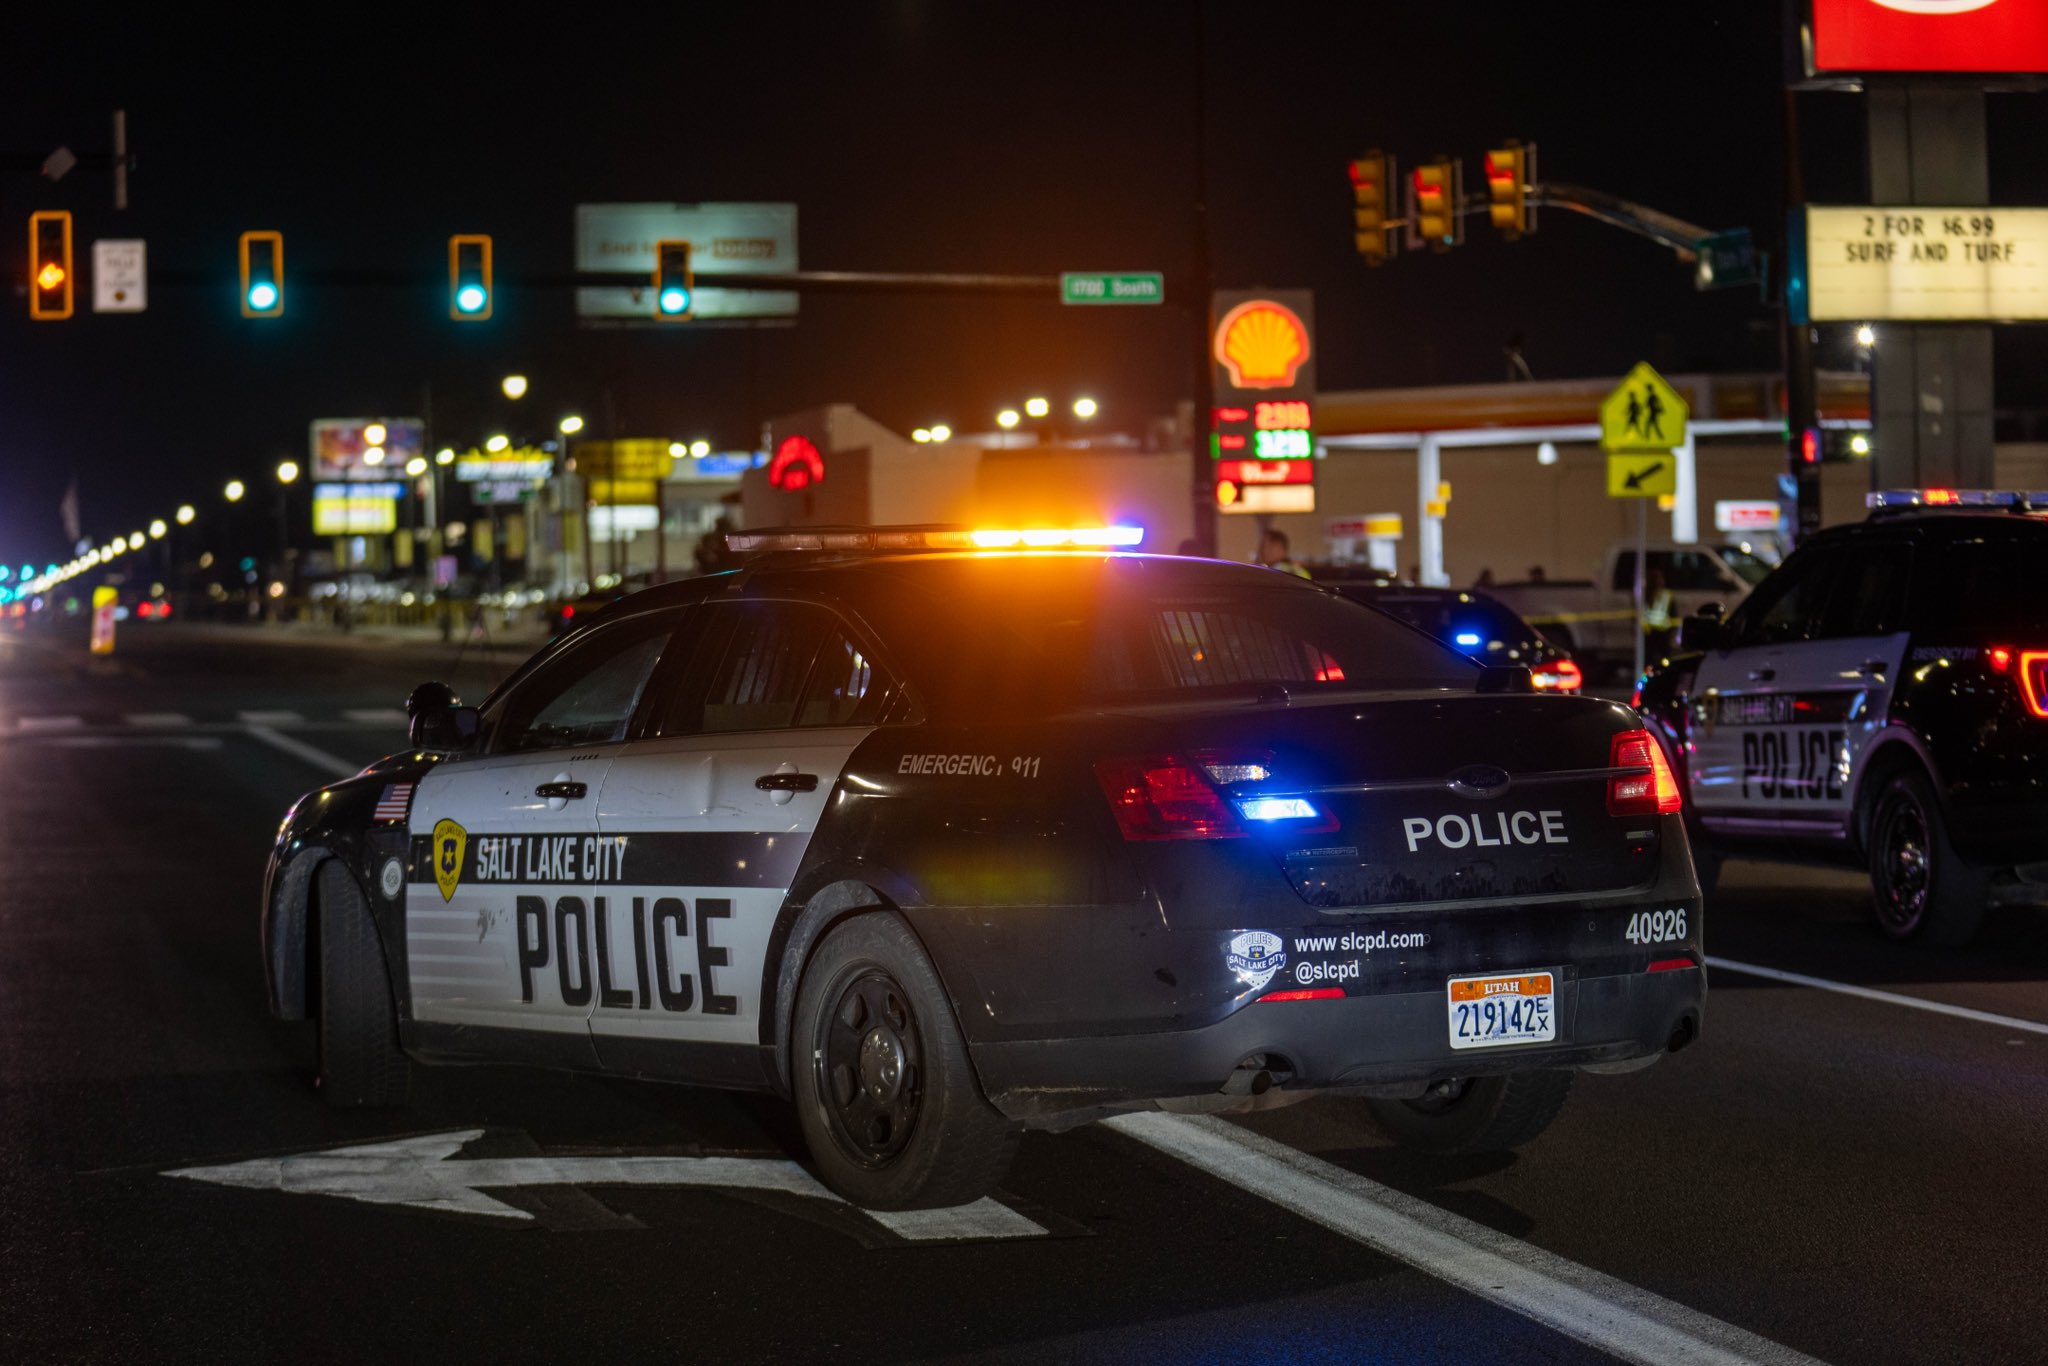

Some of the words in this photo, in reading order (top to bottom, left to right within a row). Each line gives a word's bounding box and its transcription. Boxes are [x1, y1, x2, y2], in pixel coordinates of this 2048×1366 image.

[1864, 217, 1874, 236] 2
[1885, 217, 1924, 236] FOR
[1943, 217, 1994, 236] $6.99
[1846, 243, 1895, 262] SURF
[1911, 243, 1948, 262] AND
[1964, 243, 2014, 262] TURF
[1113, 280, 1156, 297] South
[1743, 730, 1846, 800] POLICE
[1402, 811, 1569, 852] POLICE
[477, 837, 522, 880] SALT
[526, 837, 577, 881] LAKE
[582, 837, 628, 881] CITY
[1625, 908, 1687, 945] 40926
[1241, 933, 1272, 947] POLICE
[1295, 938, 1337, 952] www
[1340, 931, 1424, 953] slcpd.com
[516, 895, 740, 1016] POLICE
[1229, 955, 1246, 967] SALT
[1248, 961, 1267, 970] LAKE
[1268, 953, 1284, 966] CITY
[1296, 960, 1359, 984] @slcpd
[1484, 981, 1520, 995] UTAH
[1457, 999, 1536, 1038] 219142
